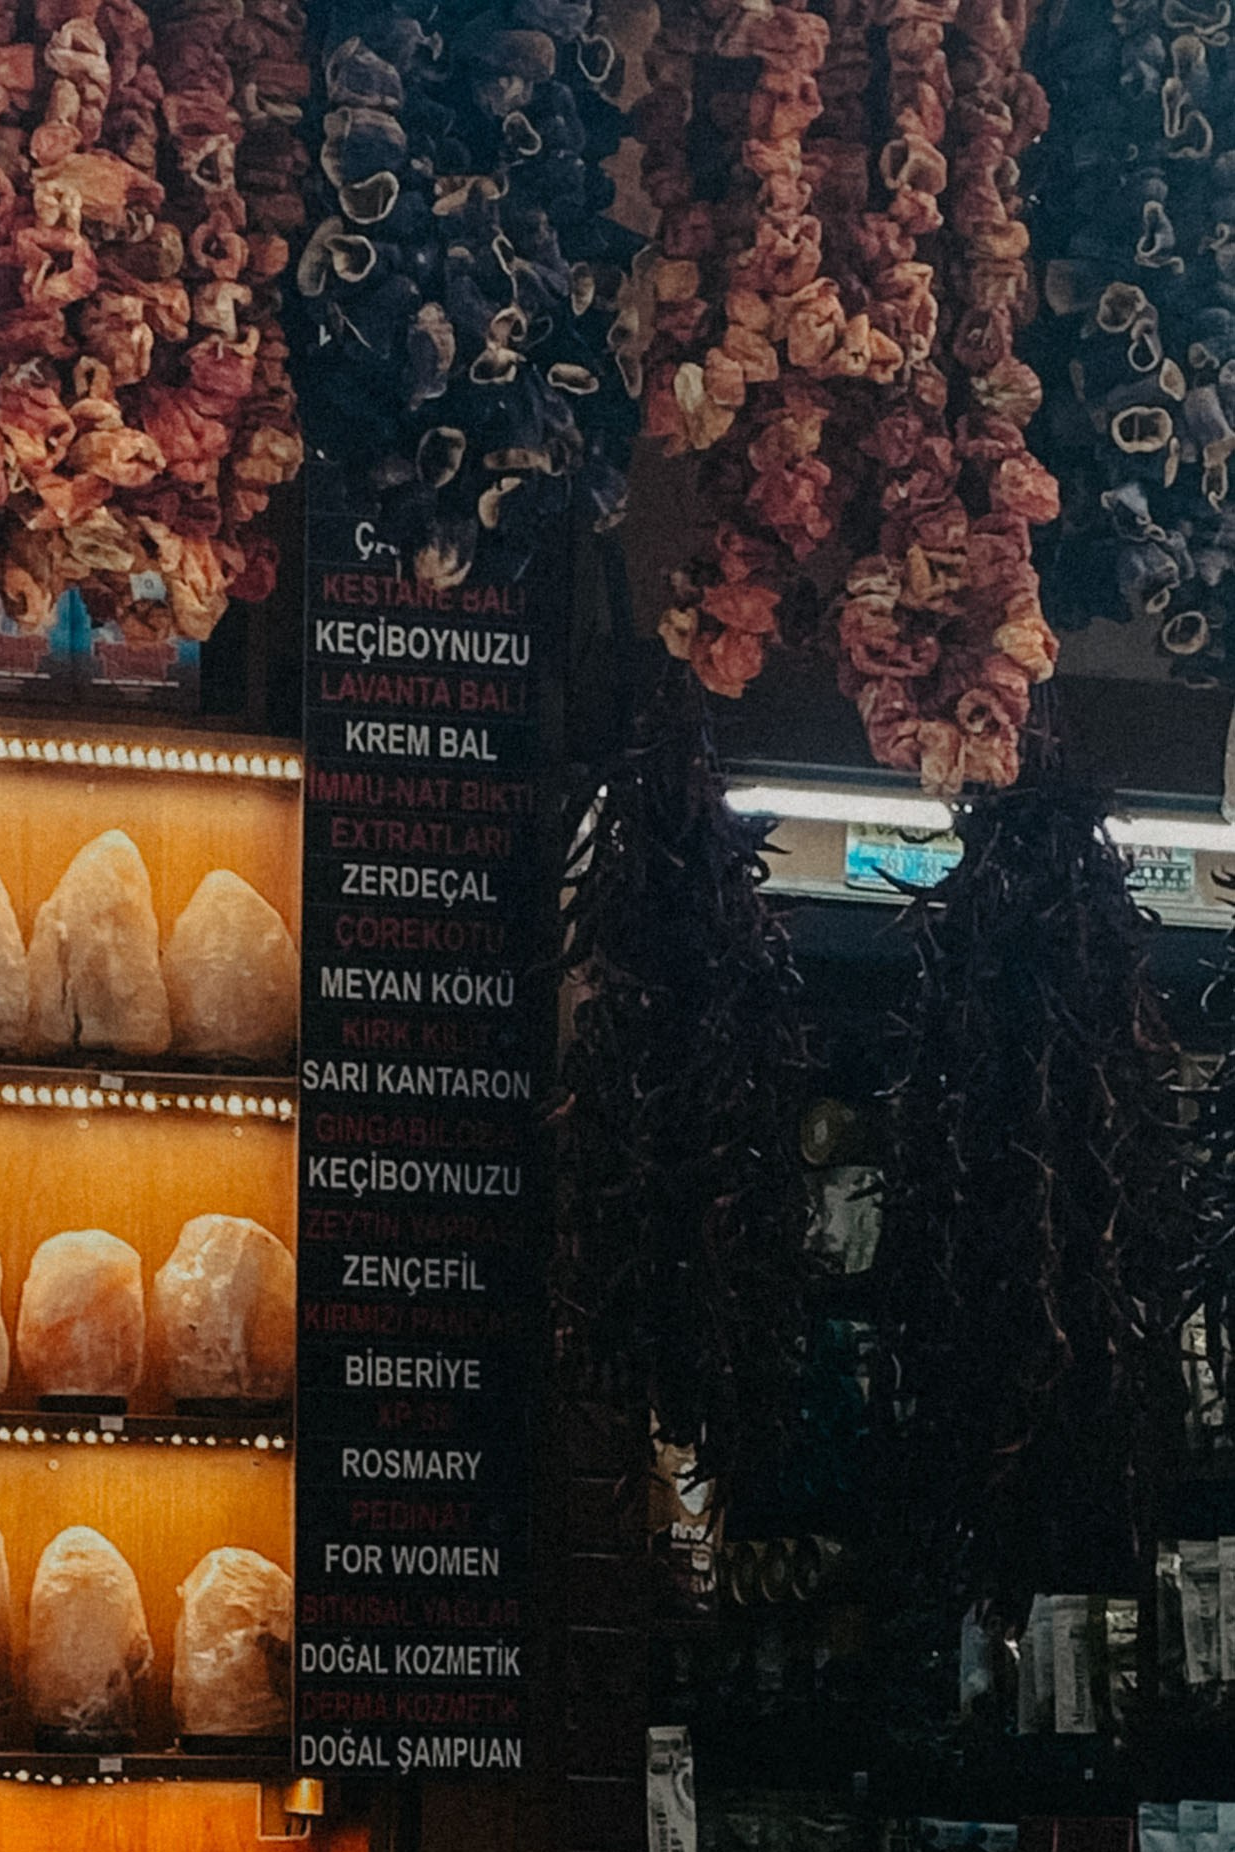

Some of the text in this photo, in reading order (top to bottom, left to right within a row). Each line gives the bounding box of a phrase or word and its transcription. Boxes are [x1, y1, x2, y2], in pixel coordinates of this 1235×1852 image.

[316, 616, 530, 665] KEÇİBOYNUZU
[321, 672, 526, 713] LAVANTA BALI
[346, 720, 498, 761] KREM BAL
[342, 863, 497, 907] ZERDEÇAL
[320, 966, 515, 1007] MEYAN KÖKÜ
[302, 1059, 531, 1100] SARI KANTARON
[308, 1151, 521, 1198] KEÇİBOYNUZU
[342, 1252, 486, 1297] ZENÇEFİL
[345, 1347, 482, 1391] BİBERİYE
[341, 1447, 482, 1481] ROSMARY
[325, 1543, 500, 1577] FOR WOMEN
[301, 1634, 522, 1677] DOĞAL KOZMETİK
[300, 1727, 522, 1775] DOĞAL ŞAMPUAN
